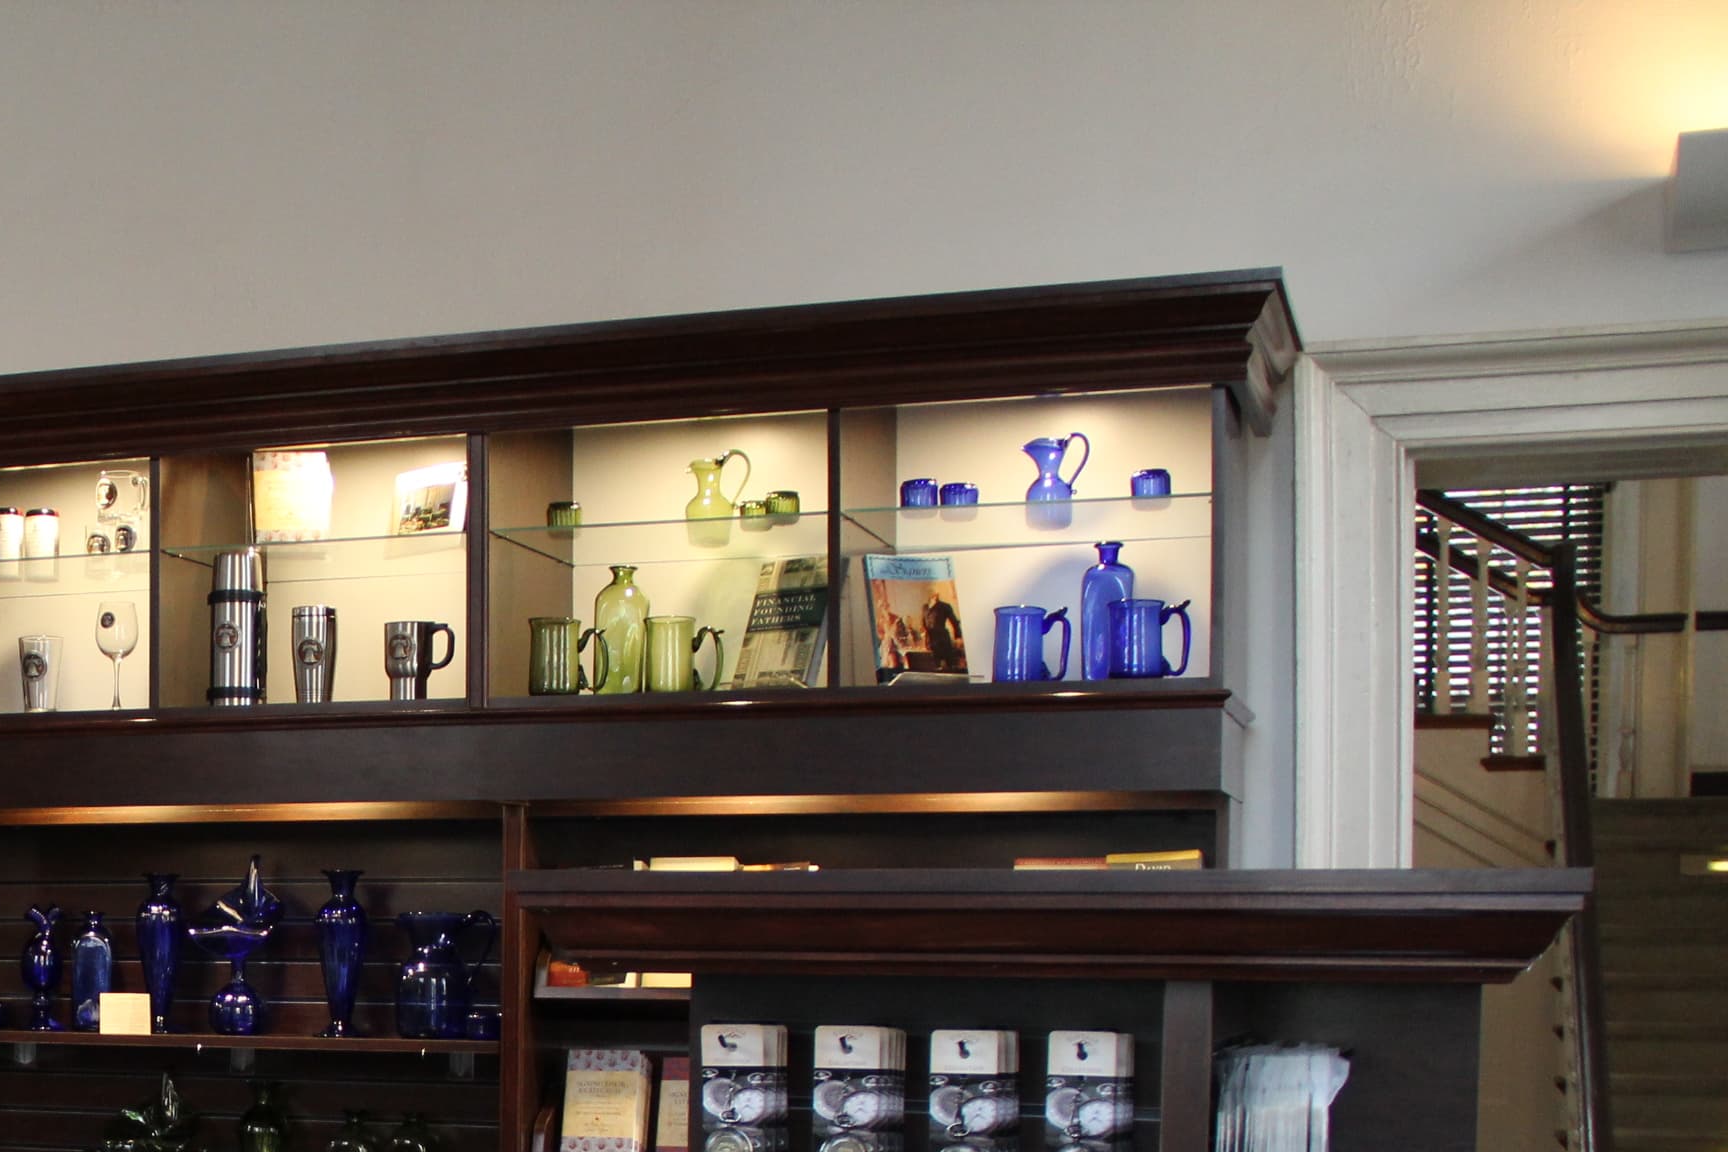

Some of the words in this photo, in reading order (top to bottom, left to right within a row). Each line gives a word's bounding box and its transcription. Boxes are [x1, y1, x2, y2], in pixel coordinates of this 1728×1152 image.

[755, 594, 816, 607] FINANCIAL
[753, 604, 815, 616] FOUNDING
[750, 615, 801, 626] FATHERS
